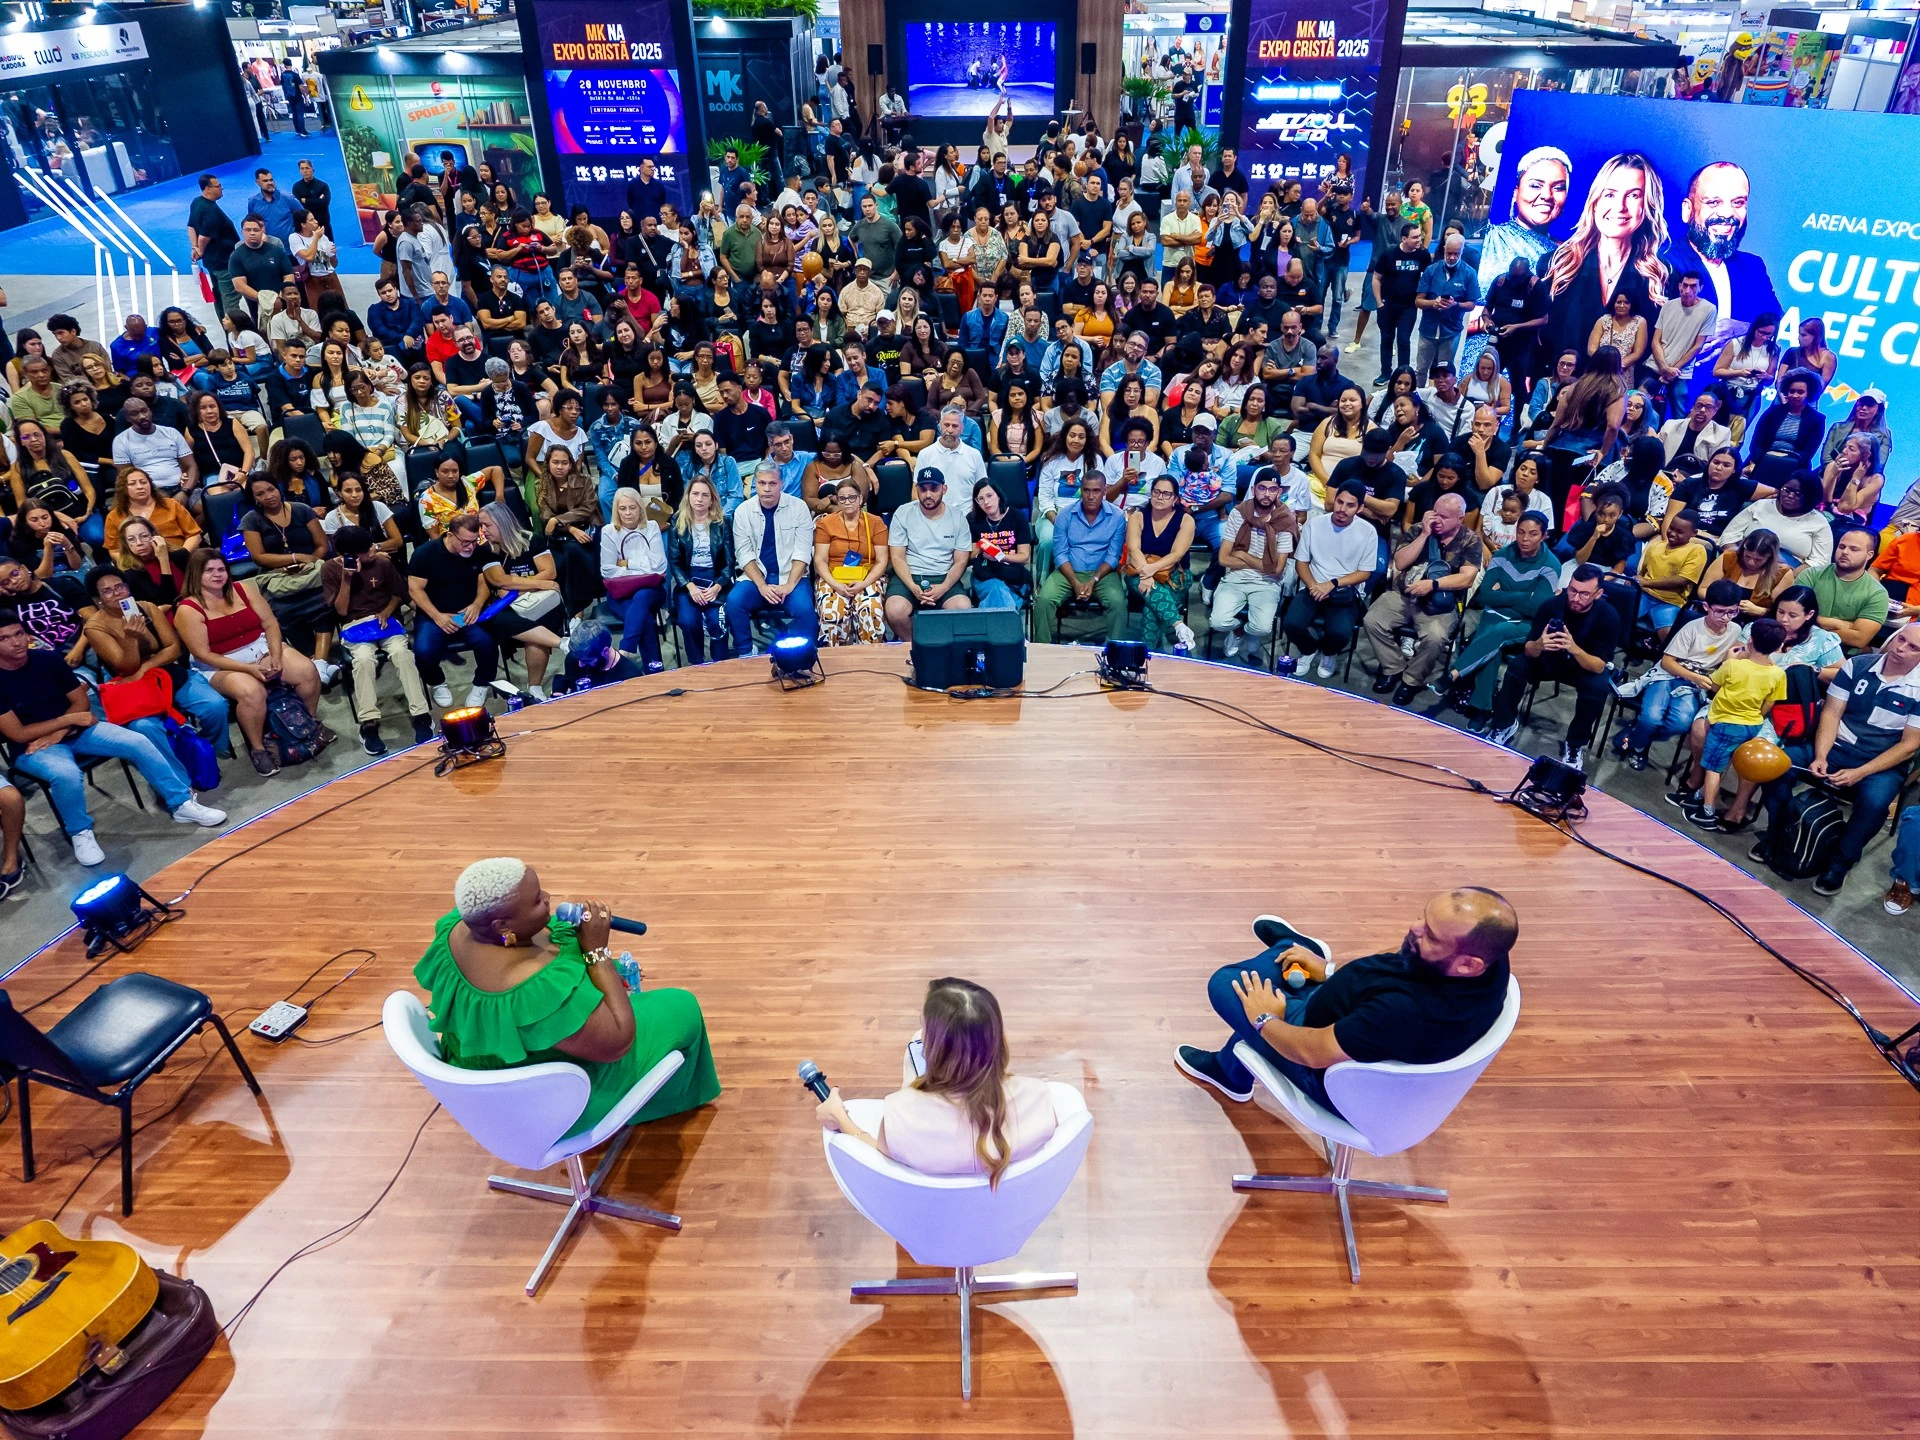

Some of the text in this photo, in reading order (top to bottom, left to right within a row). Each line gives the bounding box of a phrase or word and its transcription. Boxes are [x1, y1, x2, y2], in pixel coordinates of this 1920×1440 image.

[585, 24, 626, 42] MK NA
[1297, 21, 1336, 39] MK NA
[553, 40, 663, 61] EXPO CRISTÃ 2025
[1259, 37, 1370, 59] EXPO CRISTÃ 2025
[597, 80, 648, 90] NOVEMBRO
[706, 70, 743, 103] MK
[407, 101, 459, 122] SPOILER
[710, 103, 744, 112] BOOKS
[1447, 82, 1489, 120] 93
[1802, 212, 1867, 235] ARENA
[1787, 249, 1920, 308] CULT
[1880, 321, 1920, 368] C
[1854, 678, 1869, 696] 8
